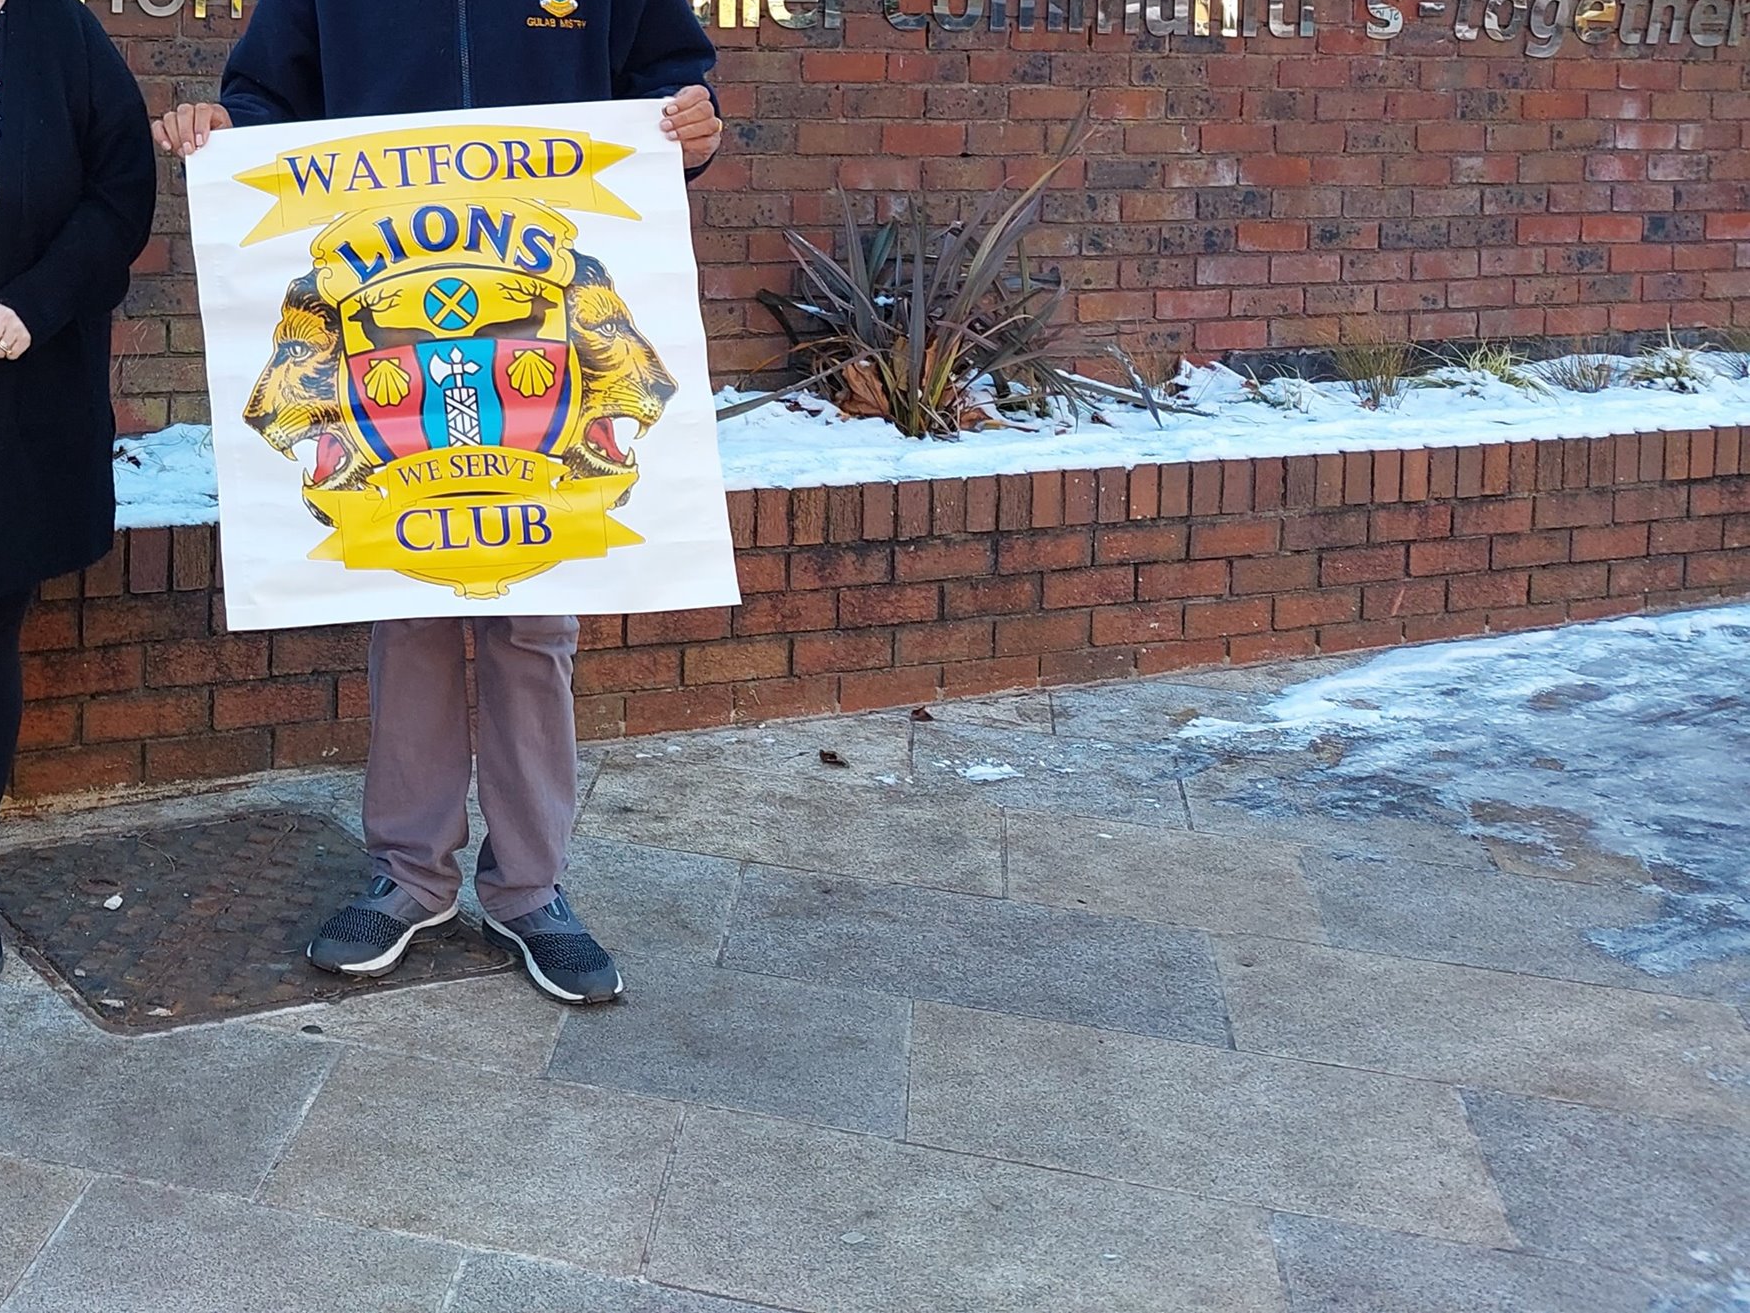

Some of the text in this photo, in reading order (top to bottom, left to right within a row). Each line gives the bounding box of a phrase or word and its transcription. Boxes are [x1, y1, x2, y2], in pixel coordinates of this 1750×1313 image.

[527, 17, 556, 27] GULAB
[282, 137, 586, 198] WATFORD
[332, 204, 556, 285] LIONS
[396, 452, 536, 488] WE SERVE
[395, 504, 553, 552] CLUB
